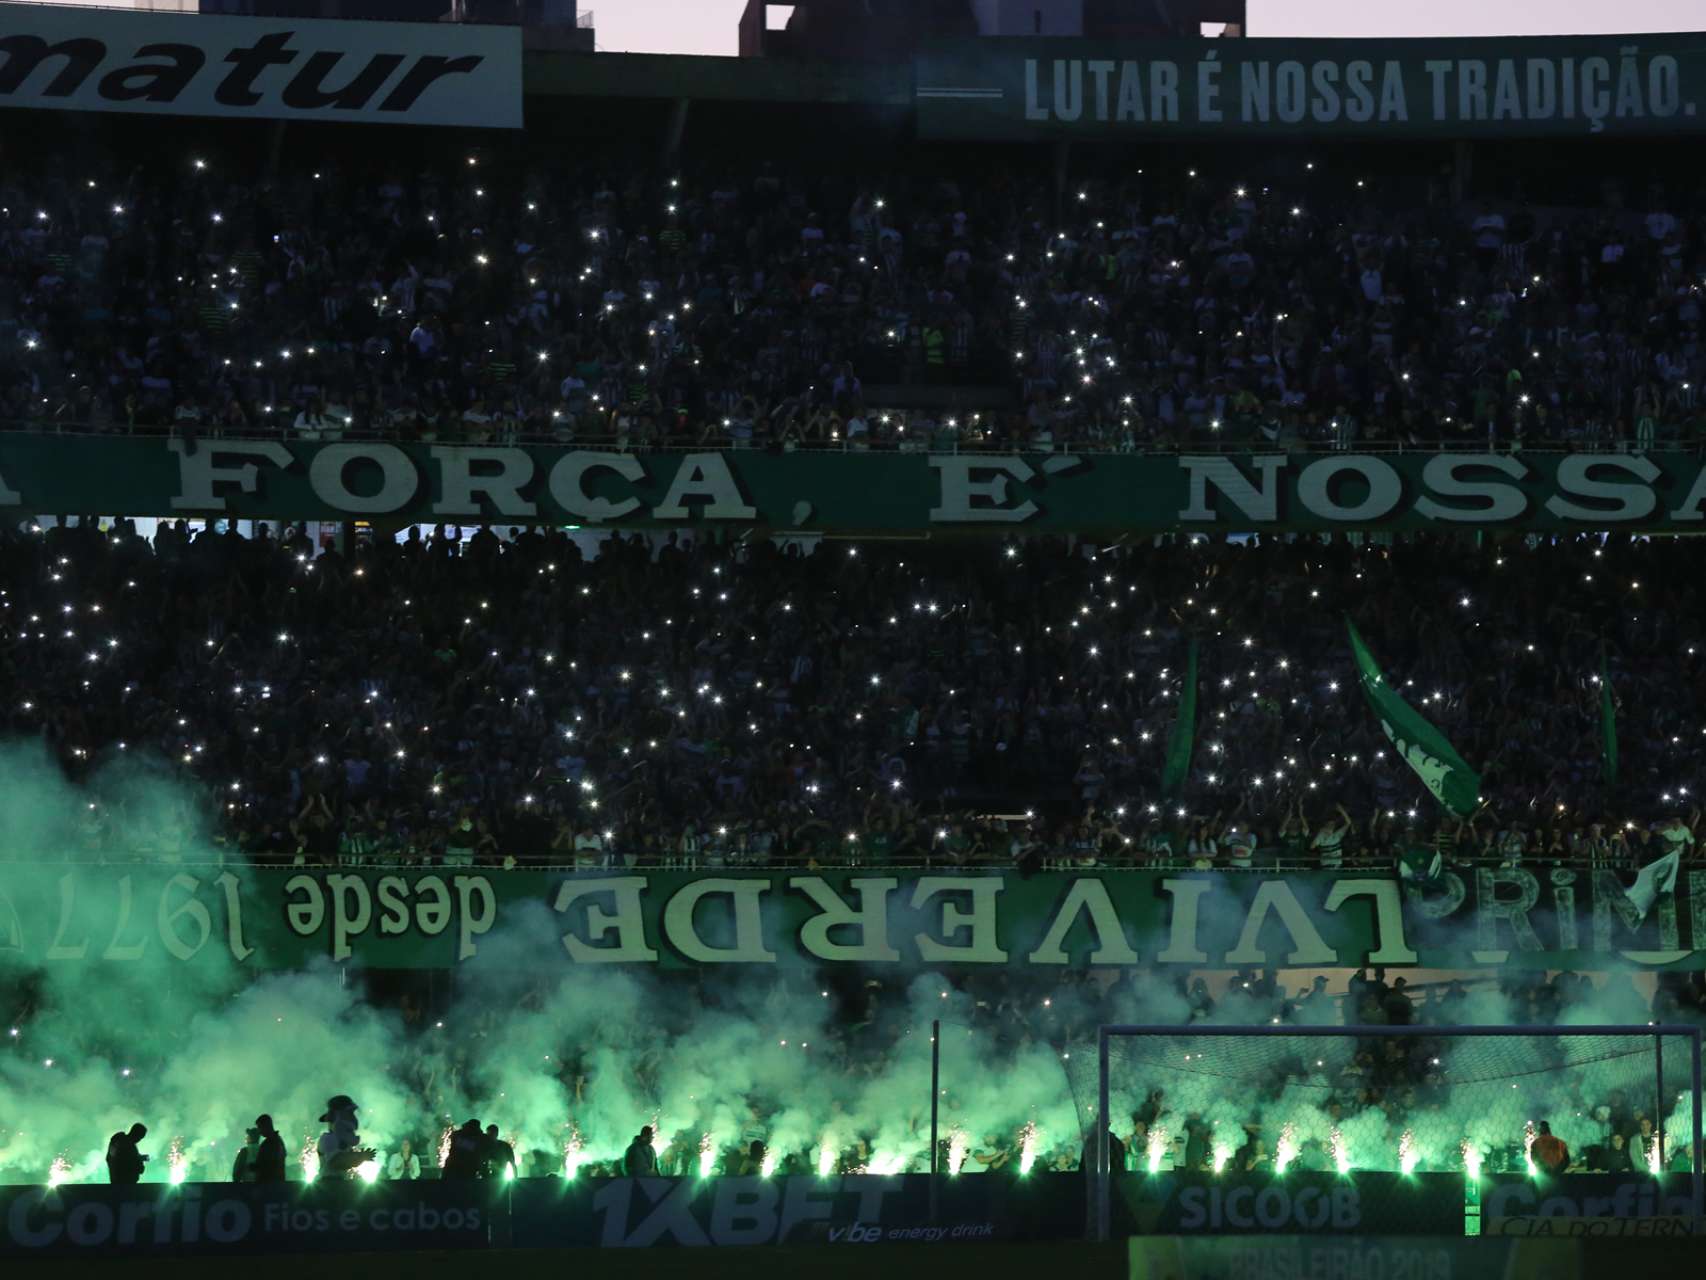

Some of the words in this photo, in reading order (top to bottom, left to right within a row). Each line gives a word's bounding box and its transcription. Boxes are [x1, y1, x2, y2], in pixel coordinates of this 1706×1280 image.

[1025, 58, 1179, 121] LUTAR
[1198, 50, 1222, 121] É
[1241, 59, 1408, 121] NOSSA
[1425, 46, 1695, 132] TRADIÇÃO.
[1178, 454, 1706, 521] NOSS
[284, 873, 497, 961] desde
[554, 874, 1510, 965] LVIVERDE
[264, 1202, 329, 1231] Fios
[340, 1209, 361, 1232] e
[370, 1201, 480, 1231] cabos
[888, 1226, 948, 1241] energy
[951, 1222, 993, 1237] drink
[1179, 1185, 1361, 1229] SICOOB
[1501, 1217, 1553, 1236] CIA
[1569, 1219, 1608, 1237] DO
